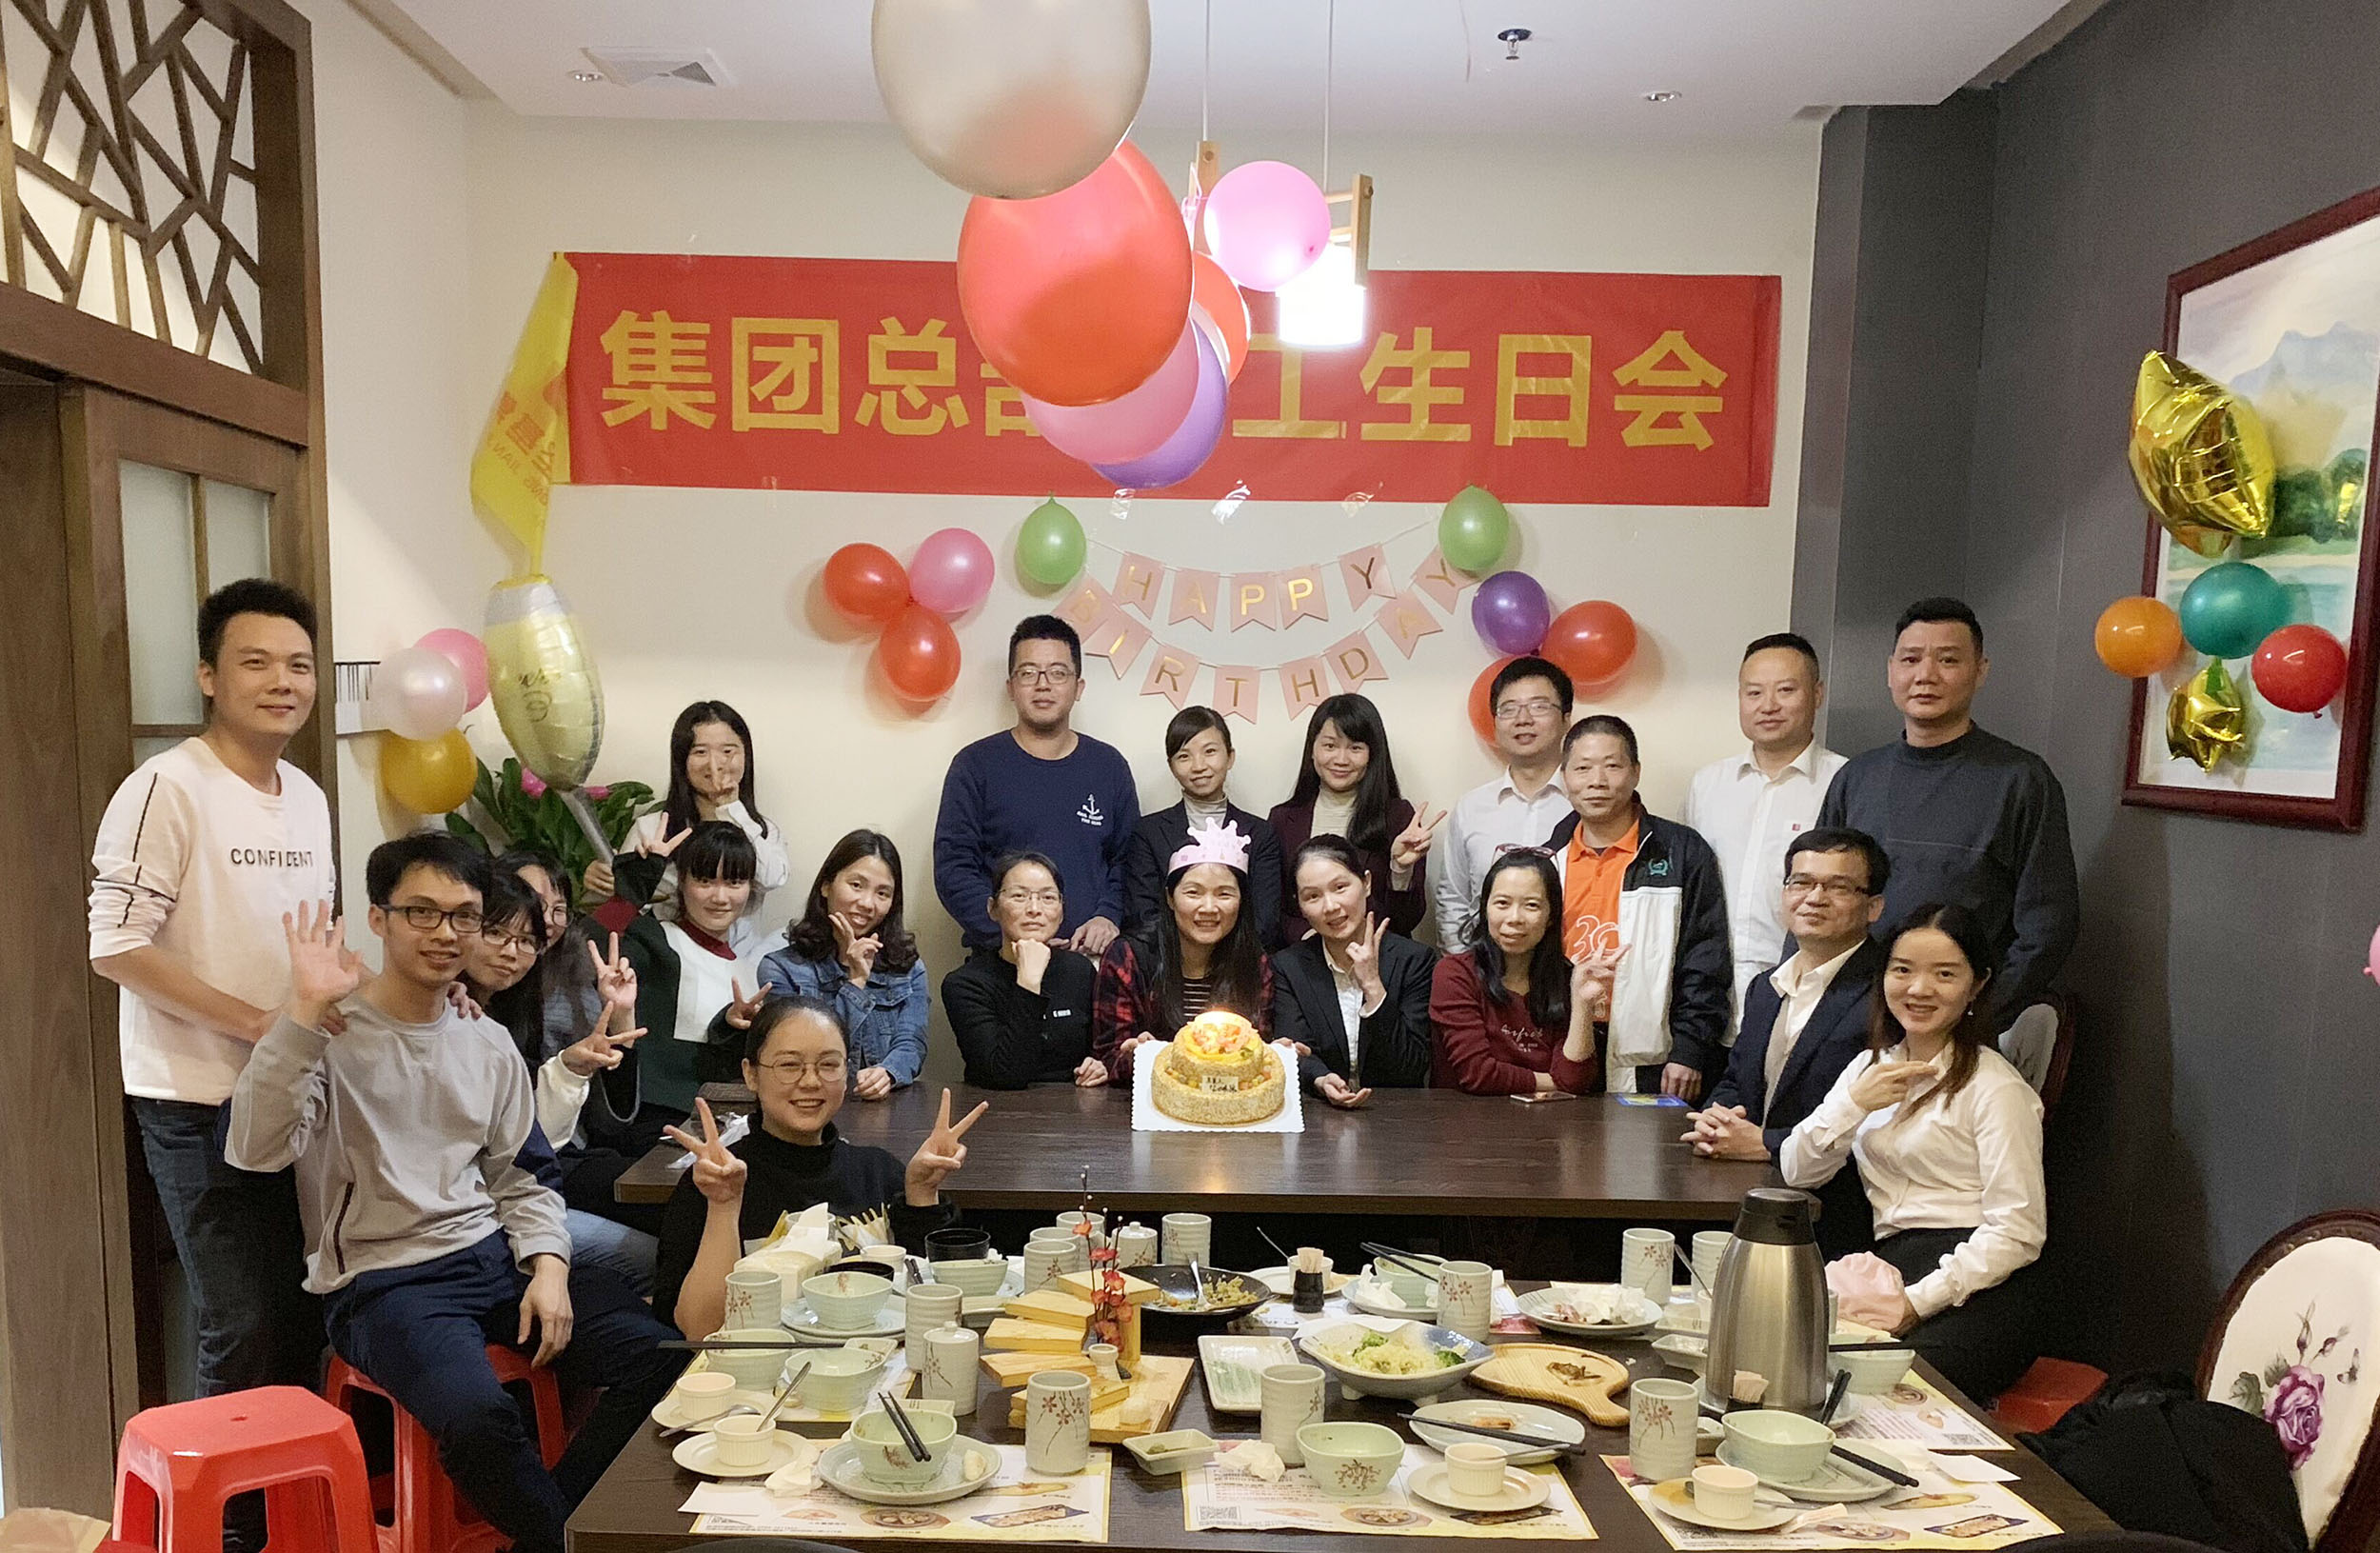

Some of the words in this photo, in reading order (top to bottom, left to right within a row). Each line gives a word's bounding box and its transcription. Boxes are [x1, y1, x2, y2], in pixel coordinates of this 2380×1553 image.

[600, 309, 1728, 451] 集团总工生日会
[1069, 558, 1457, 707] BIRTHDAY
[1127, 556, 1376, 615] HAPPY
